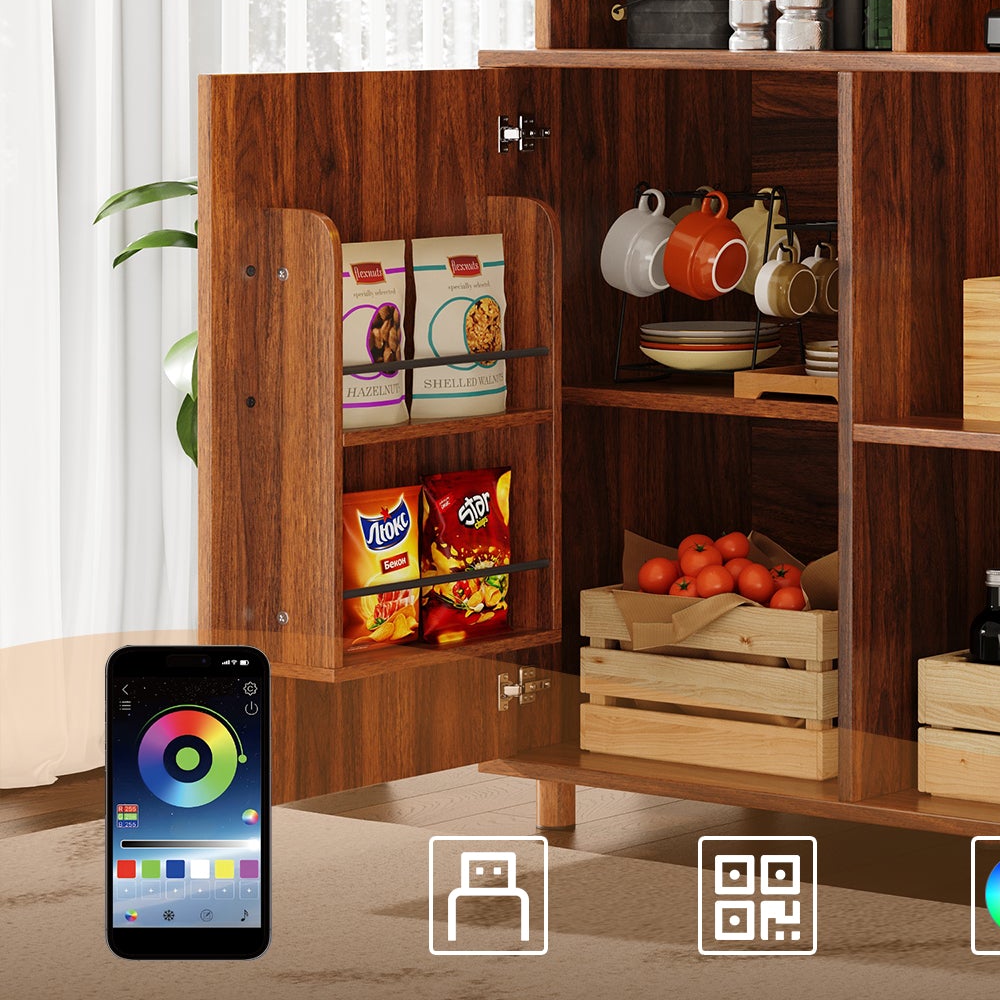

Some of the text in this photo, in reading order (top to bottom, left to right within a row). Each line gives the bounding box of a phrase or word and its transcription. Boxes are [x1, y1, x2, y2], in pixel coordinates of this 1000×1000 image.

[451, 259, 479, 273] flexnuts
[353, 266, 382, 281] flexnuts
[423, 377, 477, 389] SHELLED
[366, 512, 409, 545] Люкс
[383, 556, 407, 570] Бекон
